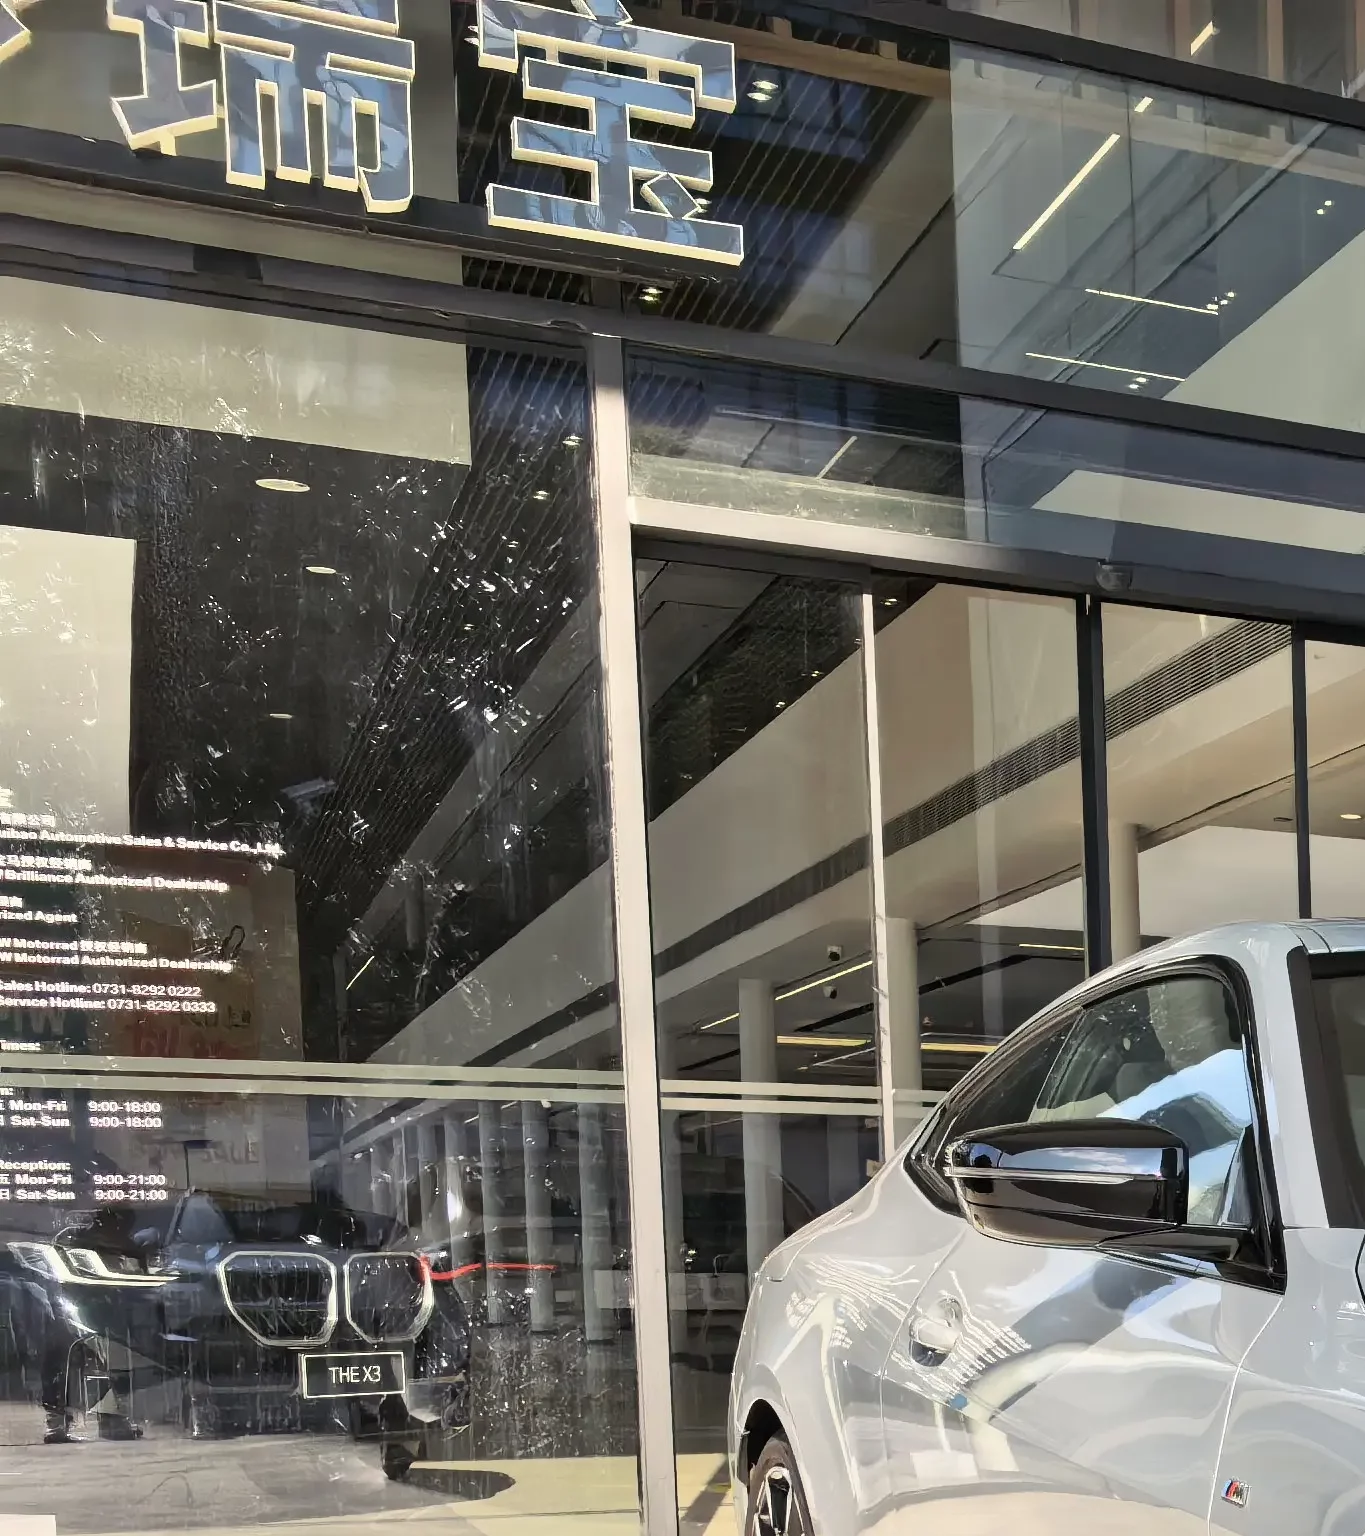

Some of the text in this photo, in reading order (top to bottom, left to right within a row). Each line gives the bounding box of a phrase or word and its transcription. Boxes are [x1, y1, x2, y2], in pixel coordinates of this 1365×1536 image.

[0, 0, 744, 264] 瑞宝
[40, 830, 121, 845] Automotive
[121, 834, 162, 847] Sales
[163, 836, 176, 848] &
[176, 838, 229, 852] Service
[5, 869, 74, 884] Brilliance
[75, 873, 152, 888] Authorized
[153, 876, 230, 893] Dealership
[34, 910, 79, 924] Agent
[13, 938, 79, 951] Motorrad
[14, 952, 80, 965] Motorrad
[81, 955, 158, 969] Authorized
[159, 958, 234, 974] Dealership
[34, 981, 91, 994] Hotline:
[92, 983, 166, 996] 0731-8292
[167, 986, 201, 997] 0222
[49, 996, 106, 1009] Hotline:
[107, 998, 180, 1012] 0731-8292
[182, 1001, 216, 1013] 0333
[9, 1100, 67, 1112] Mon-Fri
[88, 1101, 162, 1112] 9:00-18:00
[11, 1115, 70, 1127] Sat-Sun
[89, 1117, 162, 1128] 9:00-18:00
[15, 1174, 73, 1185] Mon-Fri
[93, 1175, 166, 1186] 9:00-21:00
[16, 1189, 76, 1200] Sat-Sun
[95, 1190, 167, 1201] 9:00-21:00
[328, 1365, 381, 1384] THE X3
